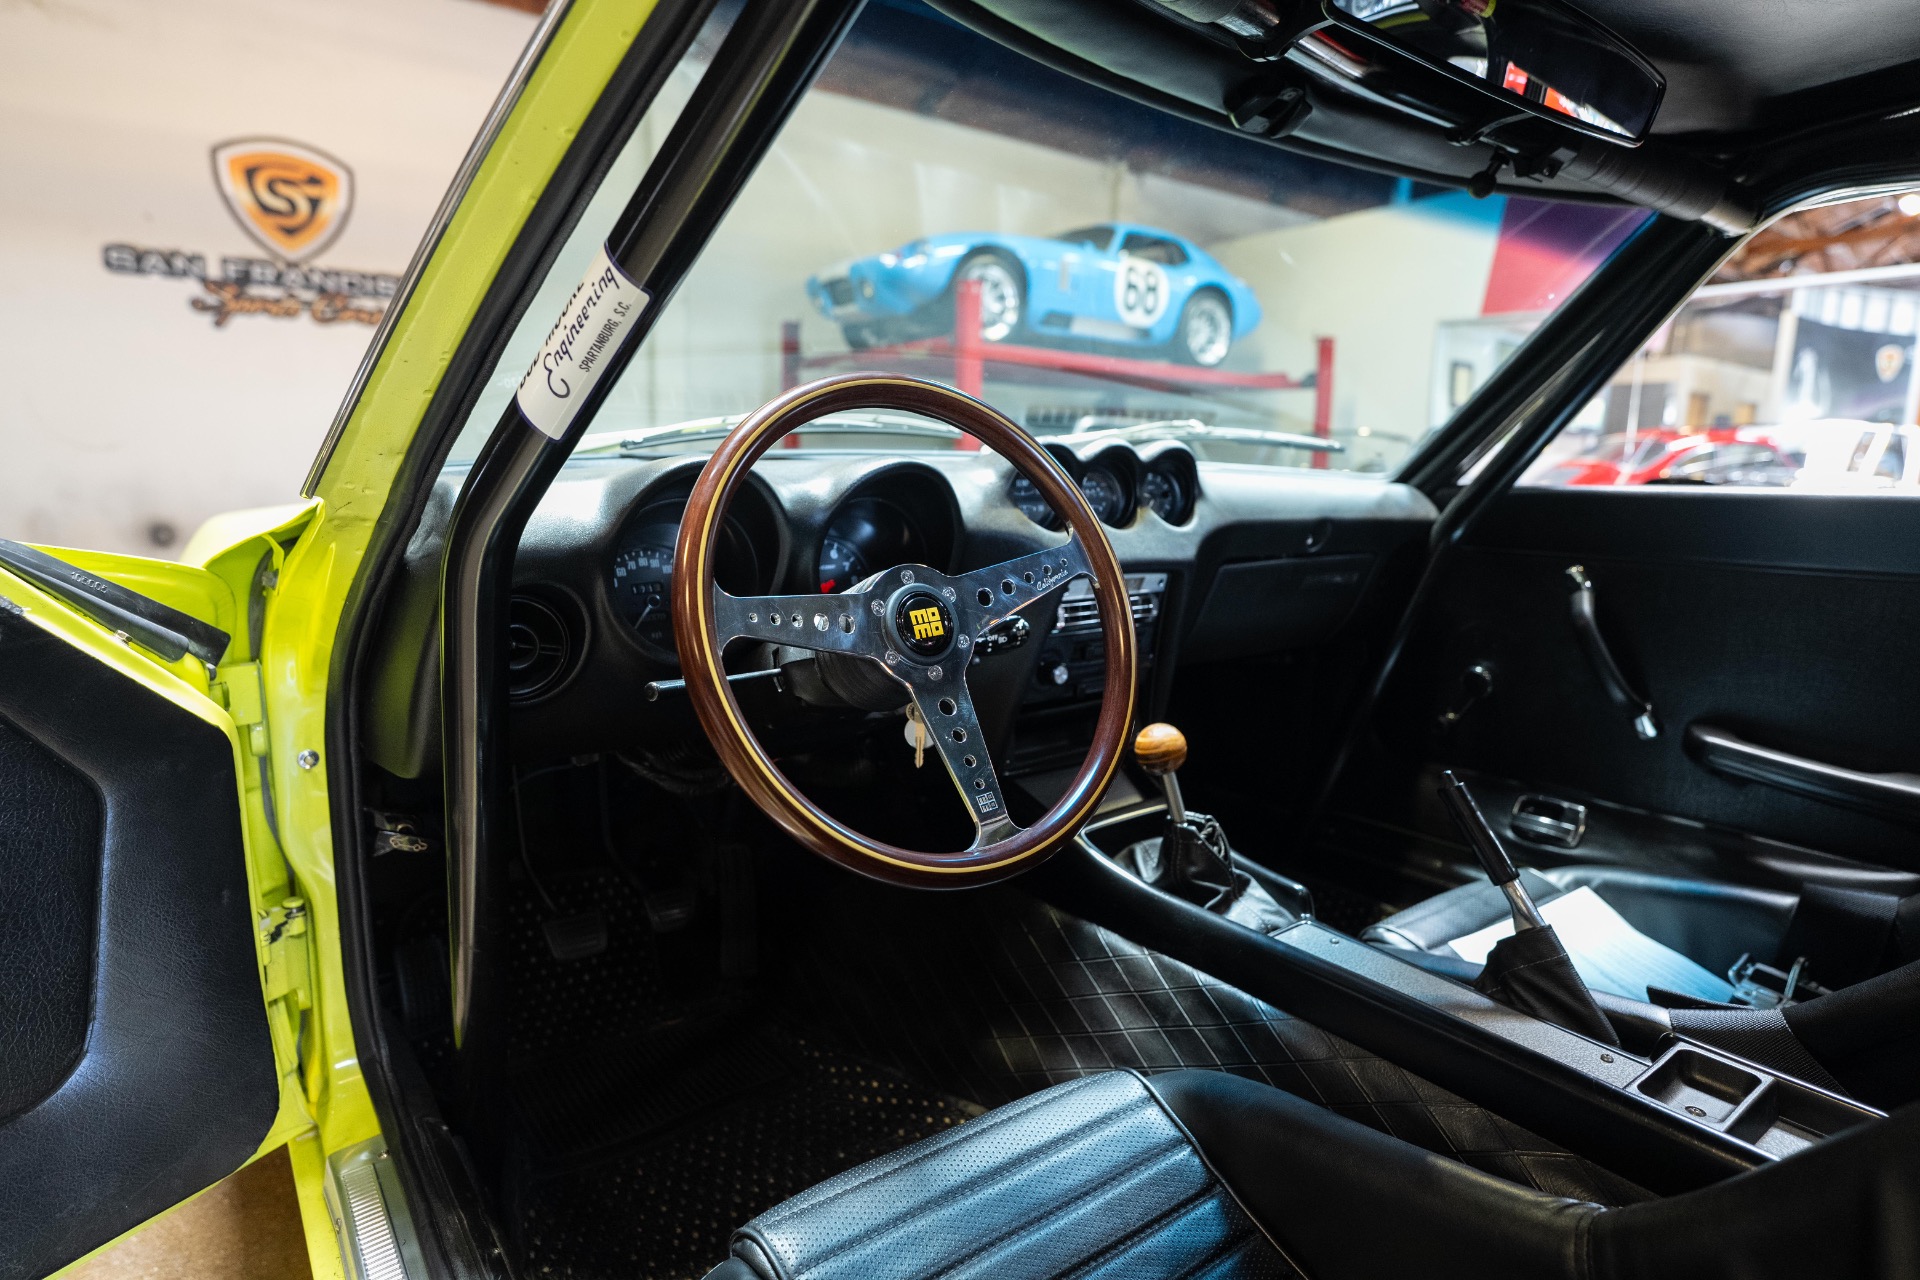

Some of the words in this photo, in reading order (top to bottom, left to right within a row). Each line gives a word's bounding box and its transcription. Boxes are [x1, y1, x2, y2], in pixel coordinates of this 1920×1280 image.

[102, 245, 207, 278] SAN
[1123, 266, 1161, 317] 68
[542, 265, 620, 399] Engineering
[579, 317, 623, 373] SPARTANBURG,
[613, 301, 632, 318] S.C.
[628, 561, 637, 570] 70
[842, 561, 850, 572] 7
